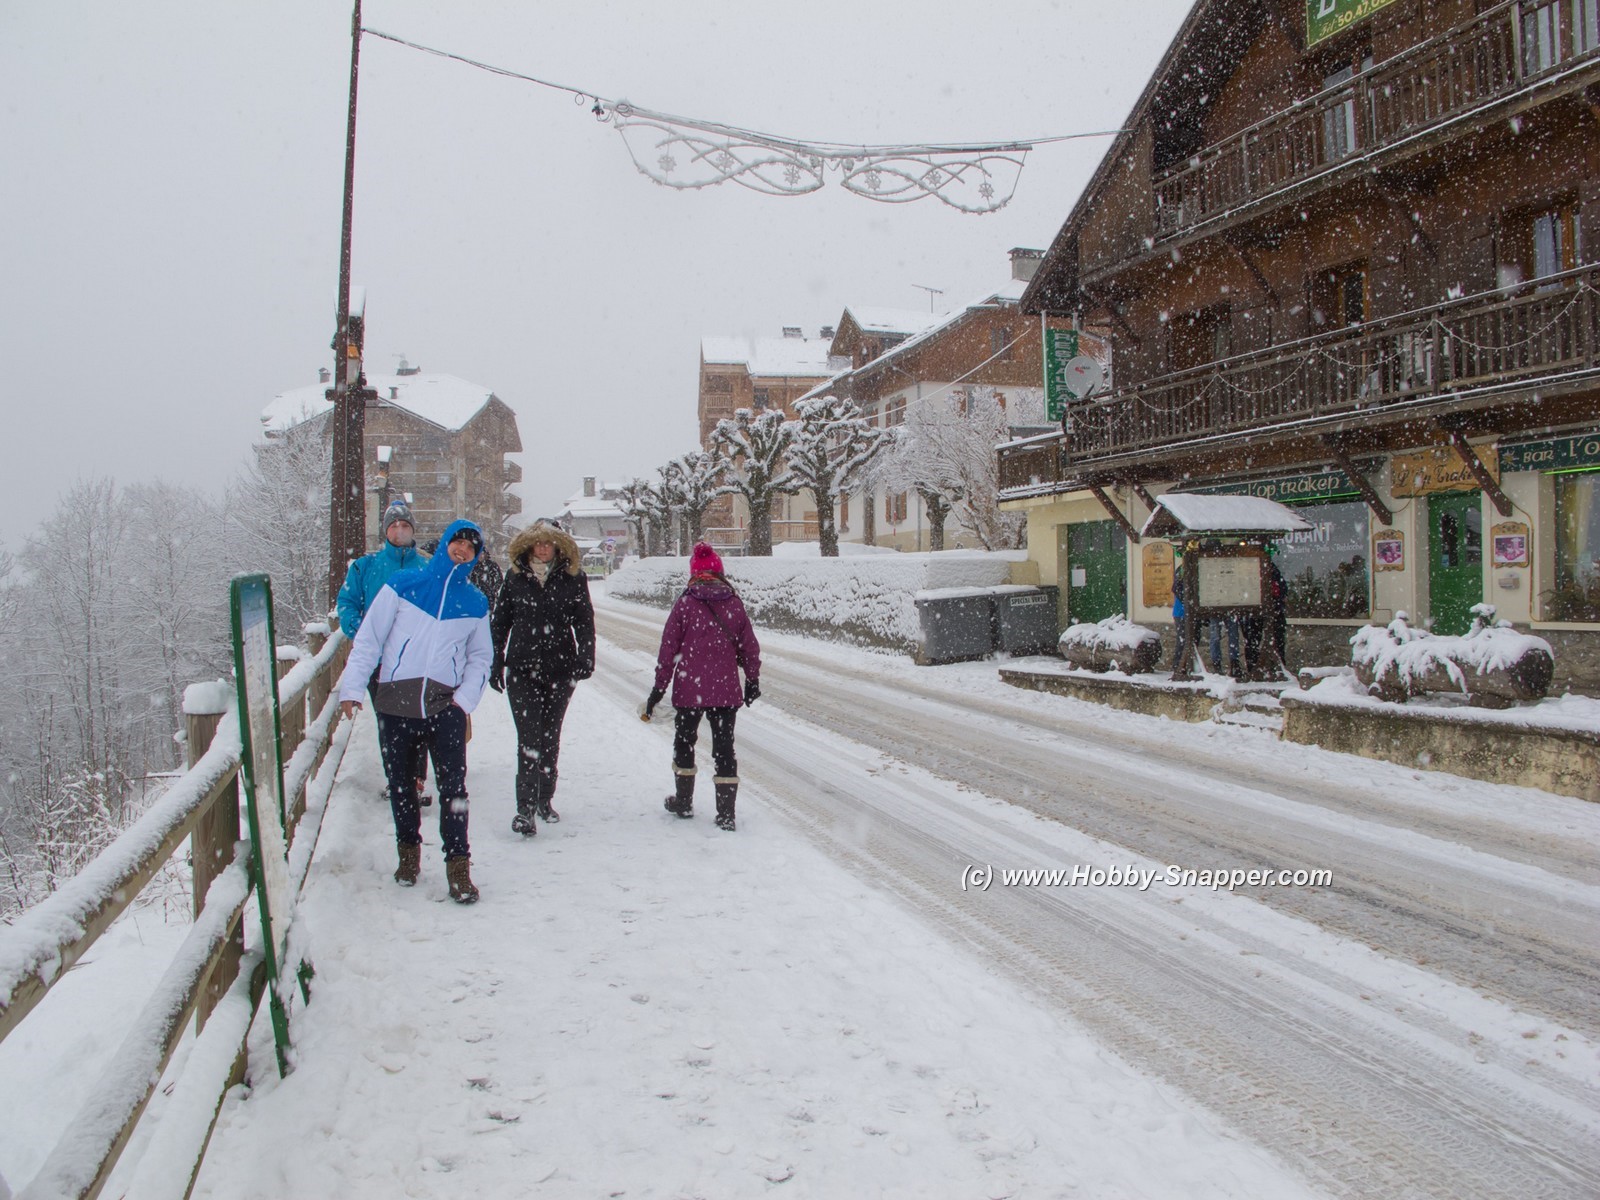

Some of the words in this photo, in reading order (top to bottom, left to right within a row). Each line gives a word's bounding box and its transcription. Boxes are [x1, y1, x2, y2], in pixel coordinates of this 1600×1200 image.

[1338, 0, 1390, 27] 50.47.0
[1523, 450, 1554, 463] BAR
[1434, 464, 1473, 483] Trake
